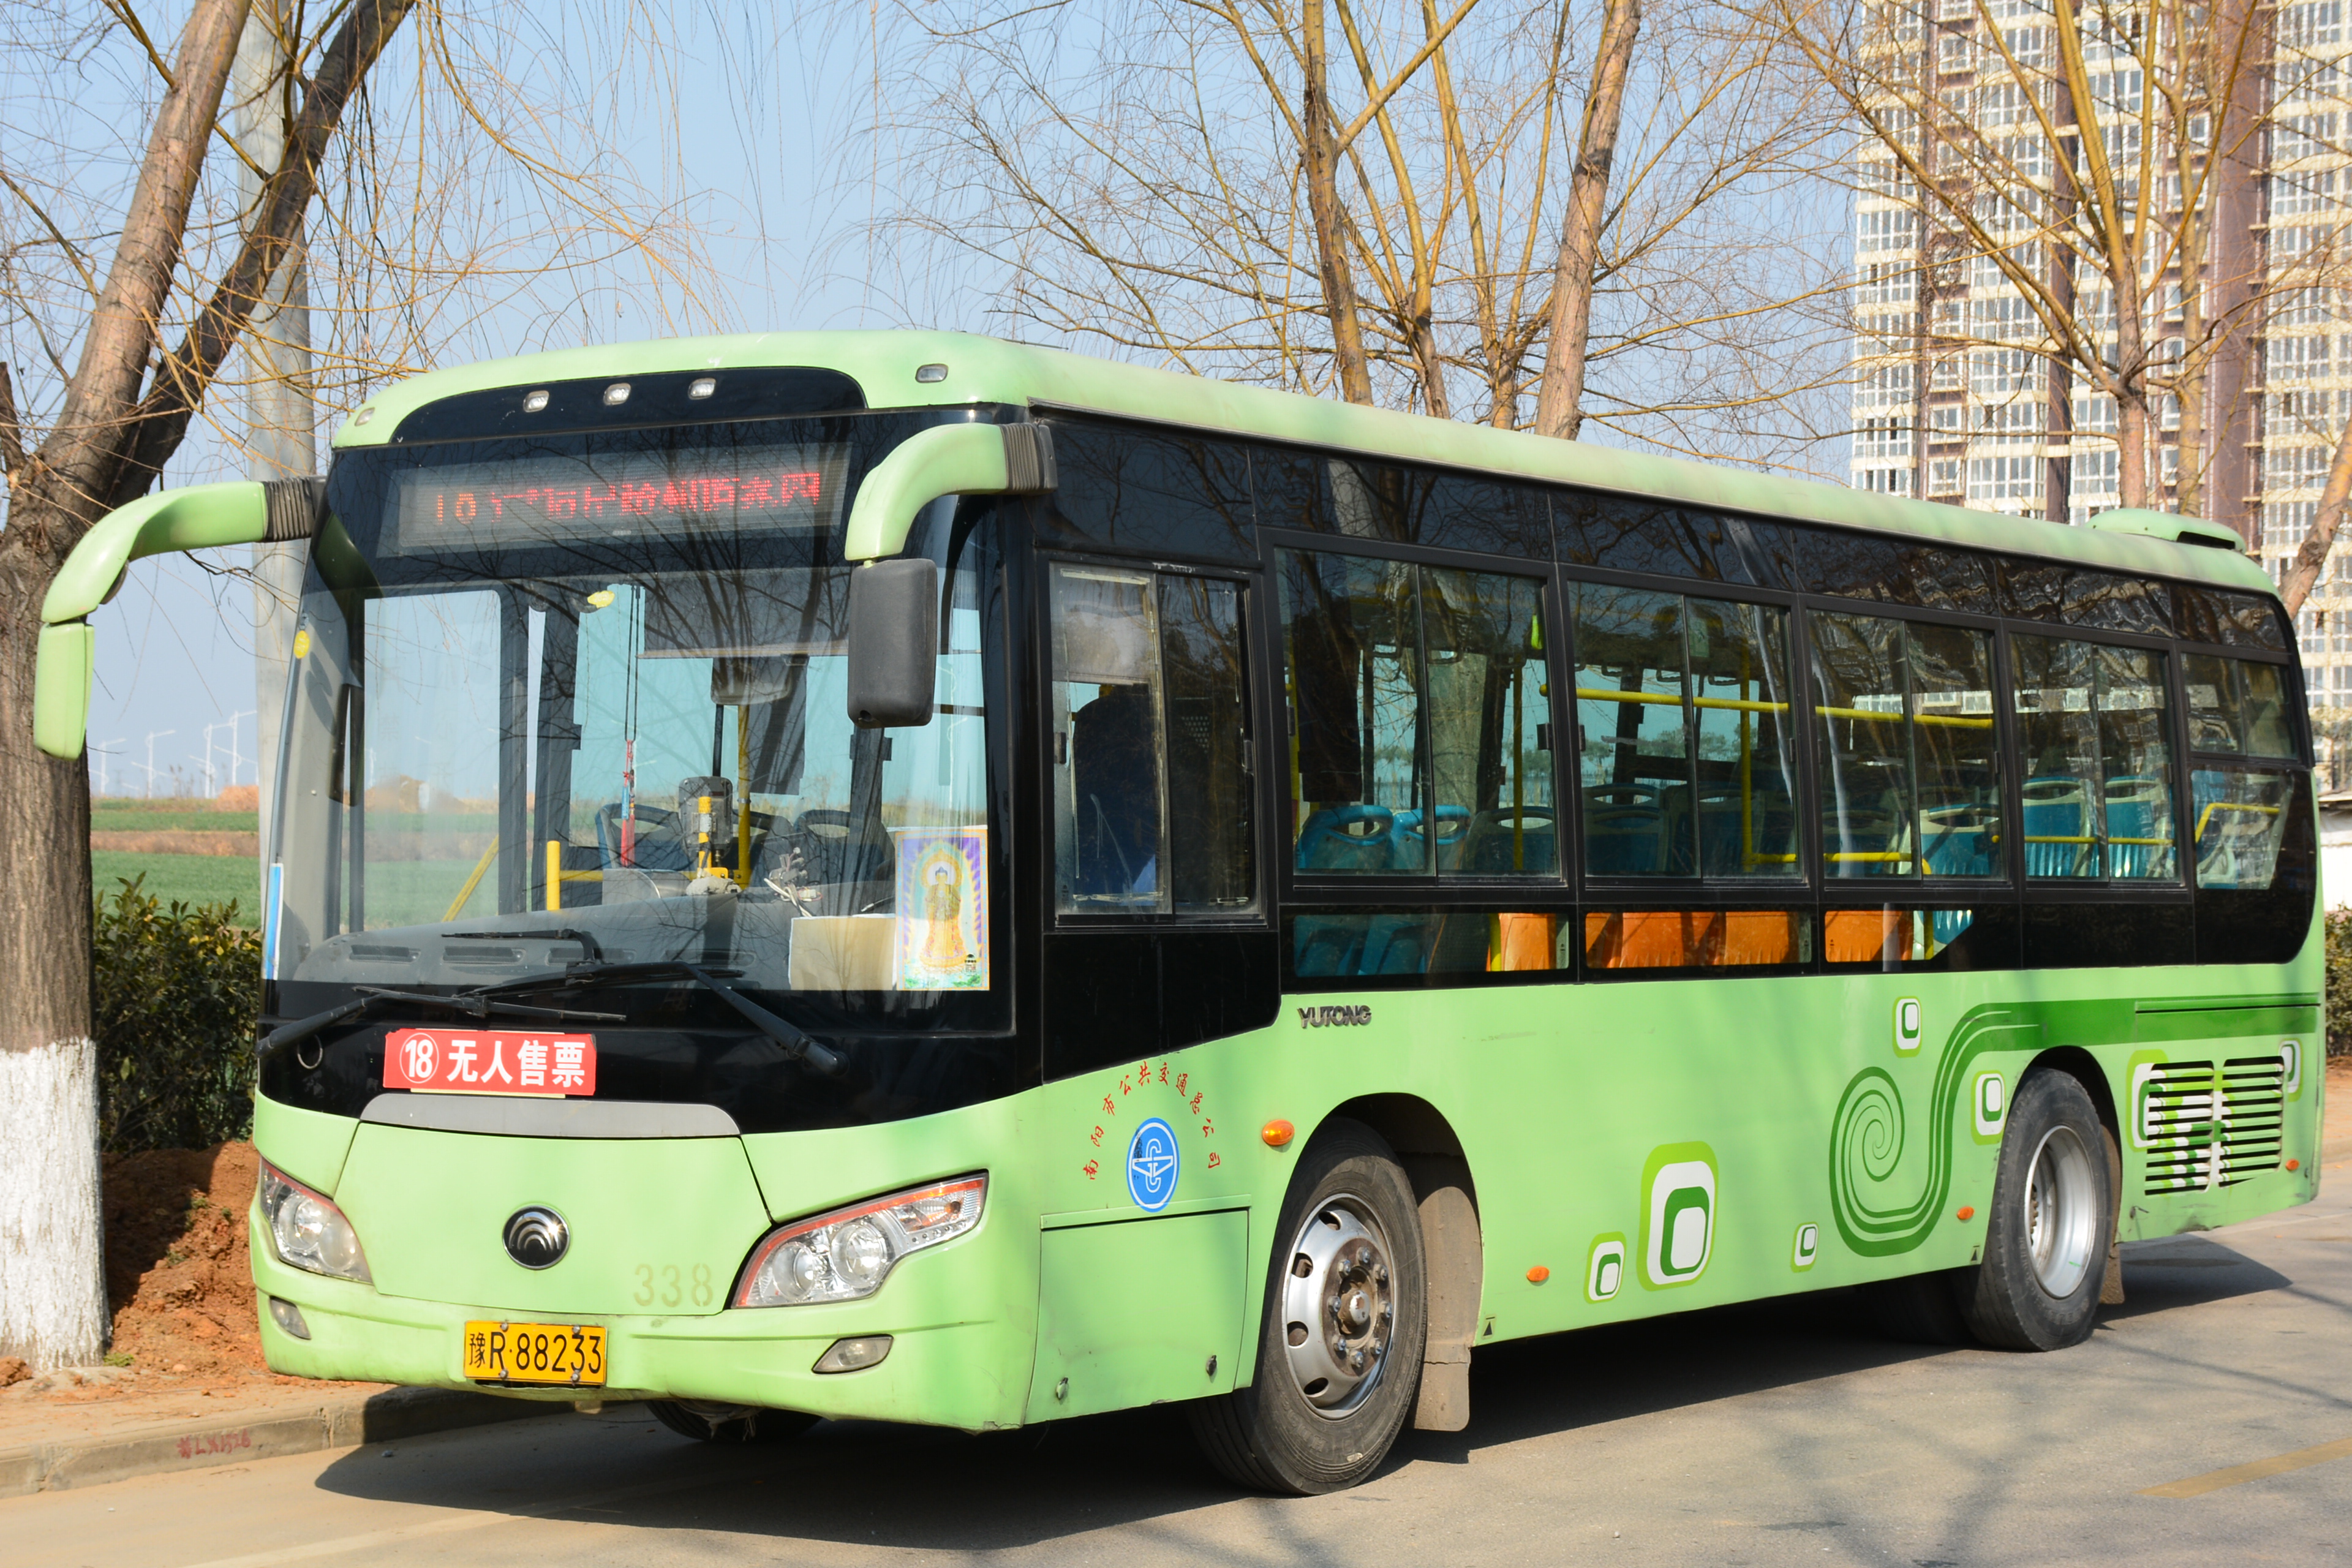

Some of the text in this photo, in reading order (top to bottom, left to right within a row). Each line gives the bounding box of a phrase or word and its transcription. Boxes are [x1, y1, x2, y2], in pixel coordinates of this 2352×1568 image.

[1297, 1005, 1372, 1029] YUTONG
[404, 1039, 586, 1088] 18 无人售票
[633, 1263, 714, 1308] 338
